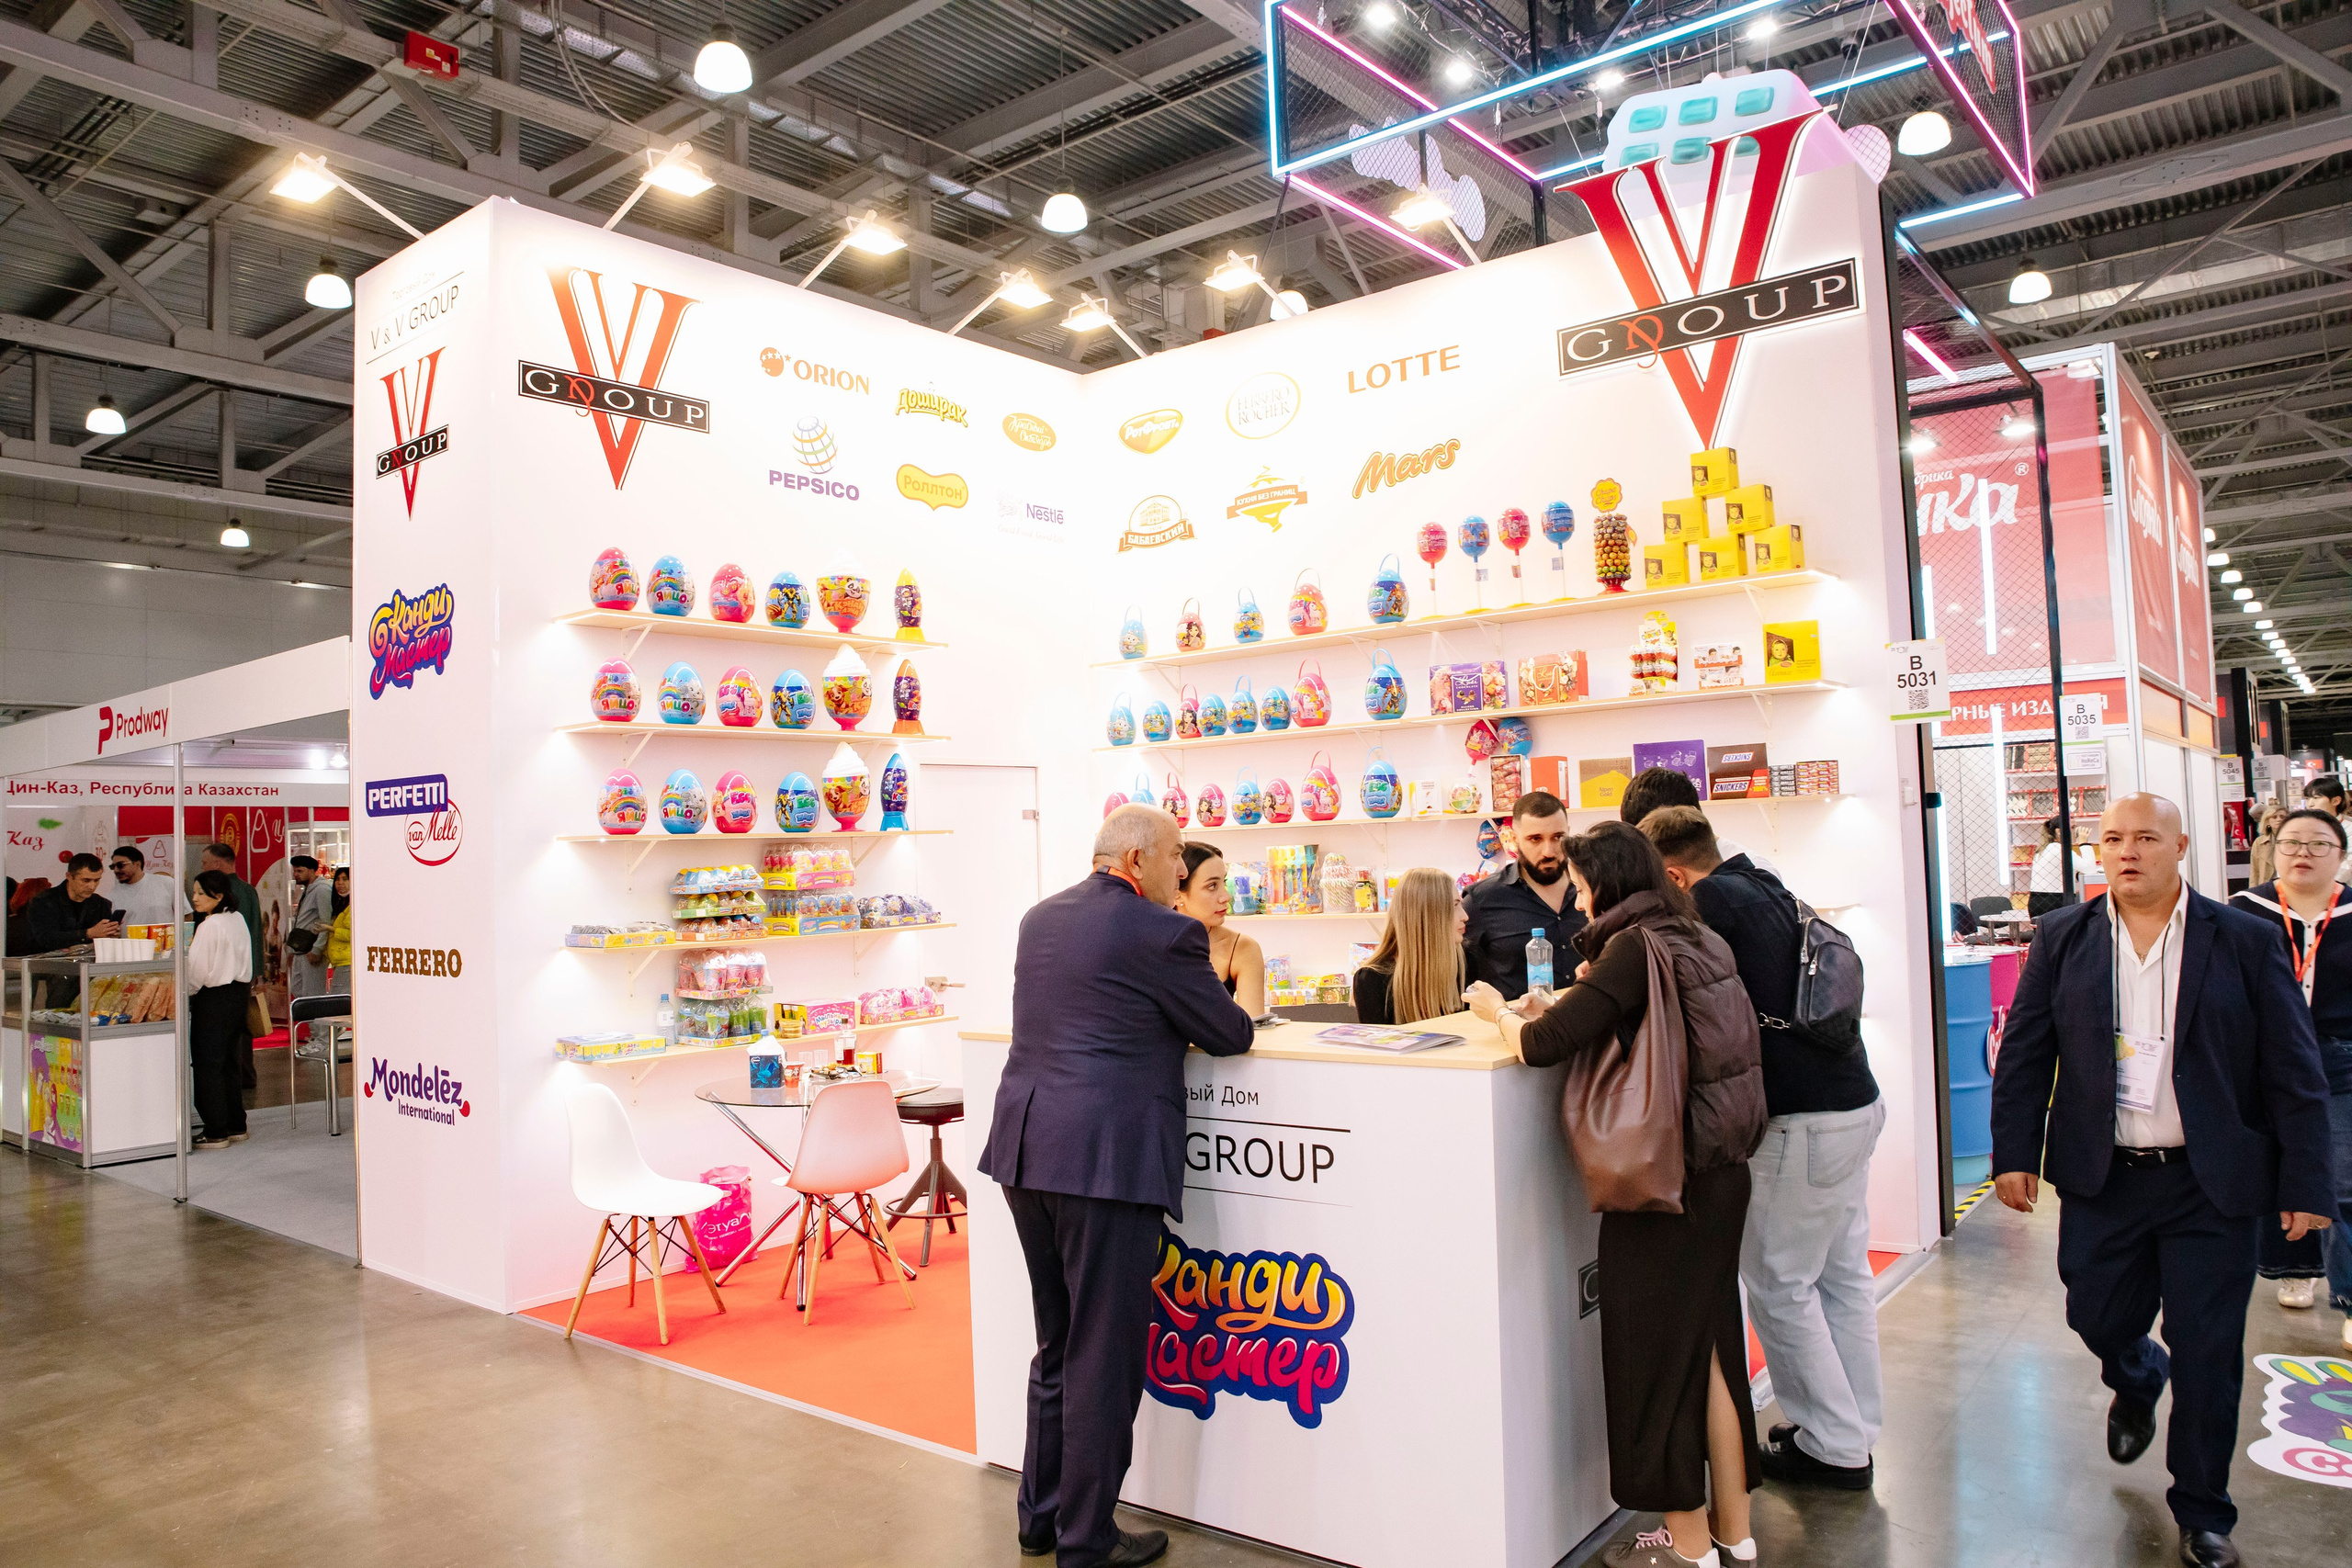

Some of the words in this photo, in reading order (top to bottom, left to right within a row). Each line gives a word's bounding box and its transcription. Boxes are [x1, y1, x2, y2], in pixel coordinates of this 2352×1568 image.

[371, 327, 380, 350] V
[384, 328, 391, 344] &
[395, 313, 404, 337] V
[410, 285, 459, 330] GROUP
[793, 359, 870, 396] ORION
[1348, 344, 1461, 394] LOTTE
[895, 388, 968, 428] Доширак
[1352, 438, 1461, 499] Mars
[1915, 469, 1955, 491] брика
[768, 469, 860, 502] PEPSICO
[1237, 496, 1258, 506] КУХНЯ
[1258, 492, 1270, 502] БЕЗ
[1270, 488, 1296, 499] ГРАНИЦ
[1127, 521, 1185, 544] БАБАЕВСКИЙ
[655, 588, 687, 604] ЯЙЦО
[369, 587, 453, 658] Канди
[1897, 671, 1938, 689] 5031
[601, 696, 635, 711] ЯЙЦО
[660, 696, 690, 712] ЯЙЦО
[1951, 702, 2006, 722] РНЫЕ
[116, 706, 169, 739] Prodway
[2067, 714, 2097, 726] 5035
[90, 781, 193, 798] Республиа
[198, 783, 279, 796] Казахстан
[368, 781, 447, 811] PERFETTI
[1714, 782, 1747, 793] SNICKERS
[426, 804, 458, 842] Melle
[662, 805, 693, 819] ЯЙЦО
[367, 946, 463, 978] FERRERO
[1184, 1084, 1215, 1102] вый
[1221, 1086, 1259, 1108] Дом
[398, 1099, 456, 1126] International
[1185, 1132, 1336, 1184] GROUP
[1148, 1323, 1340, 1415] астер
